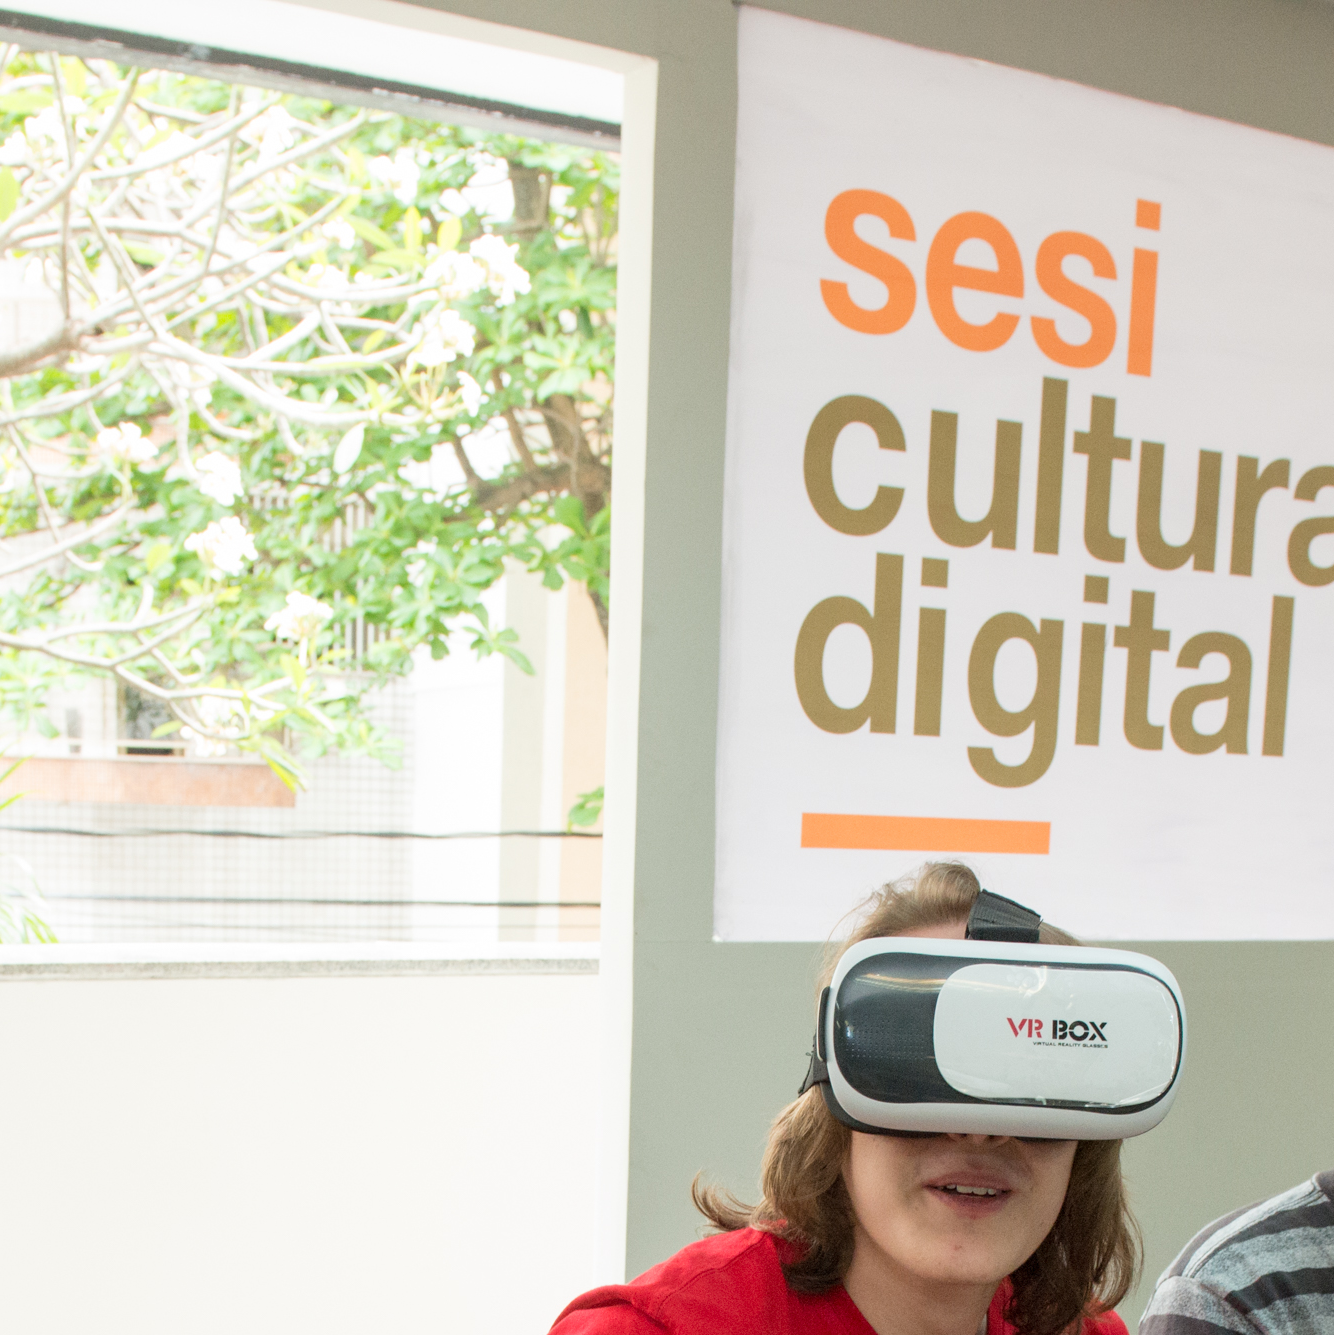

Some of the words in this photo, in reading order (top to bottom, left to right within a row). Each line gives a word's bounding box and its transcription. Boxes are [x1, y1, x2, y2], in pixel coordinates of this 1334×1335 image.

[819, 188, 1162, 378] sesi
[793, 552, 1296, 789] digital
[1006, 1017, 1043, 1038] VR
[1052, 1019, 1108, 1042] BOX
